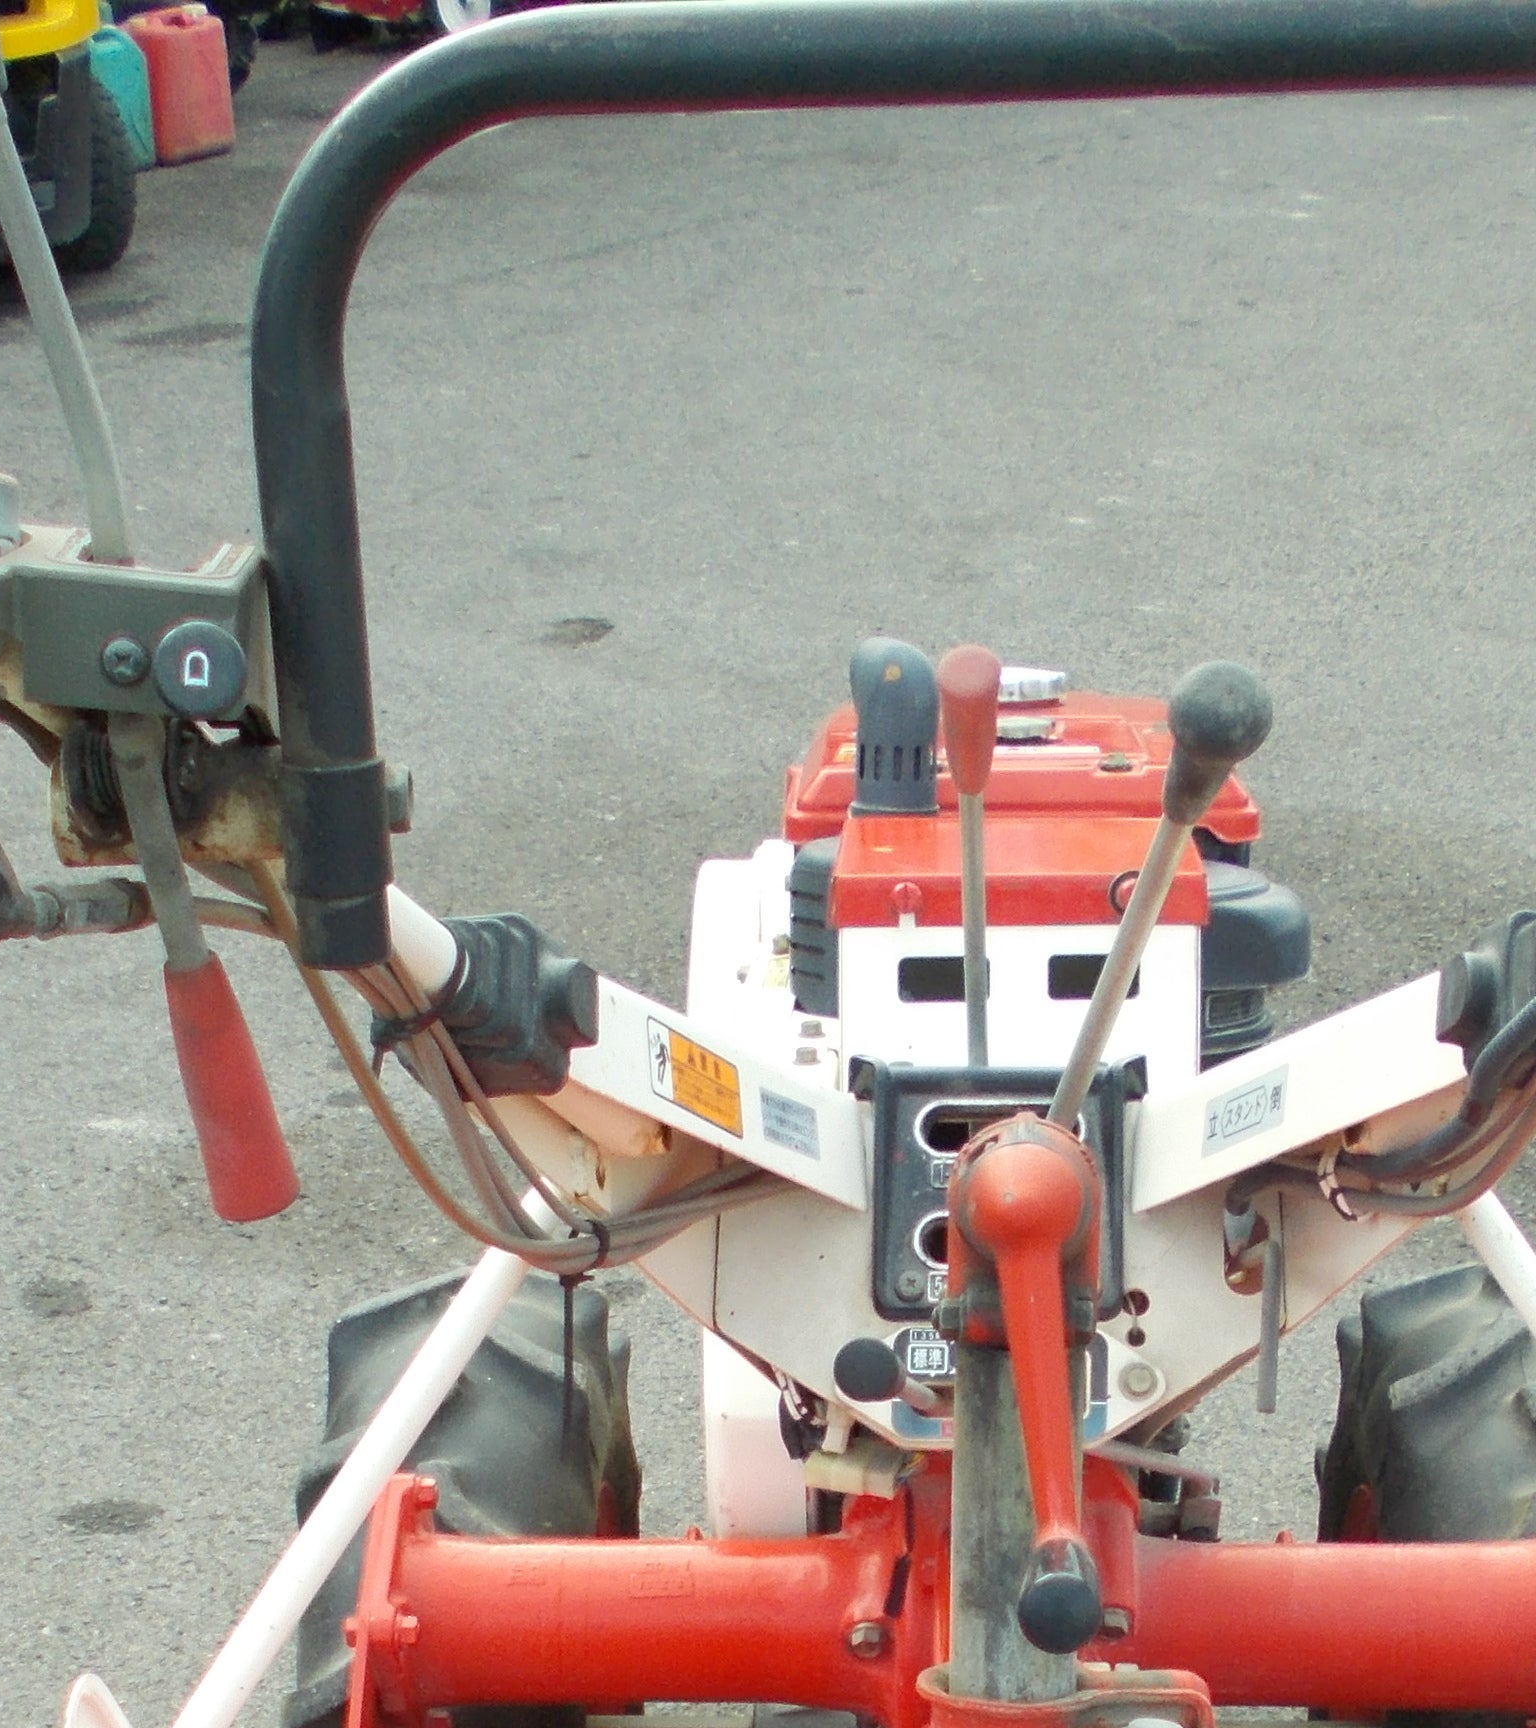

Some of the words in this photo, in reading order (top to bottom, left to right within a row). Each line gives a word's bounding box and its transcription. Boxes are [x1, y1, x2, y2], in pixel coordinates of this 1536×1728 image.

[1207, 1111, 1218, 1140] 立
[1224, 1092, 1265, 1129] スタンド
[913, 1347, 943, 1369] 標準
